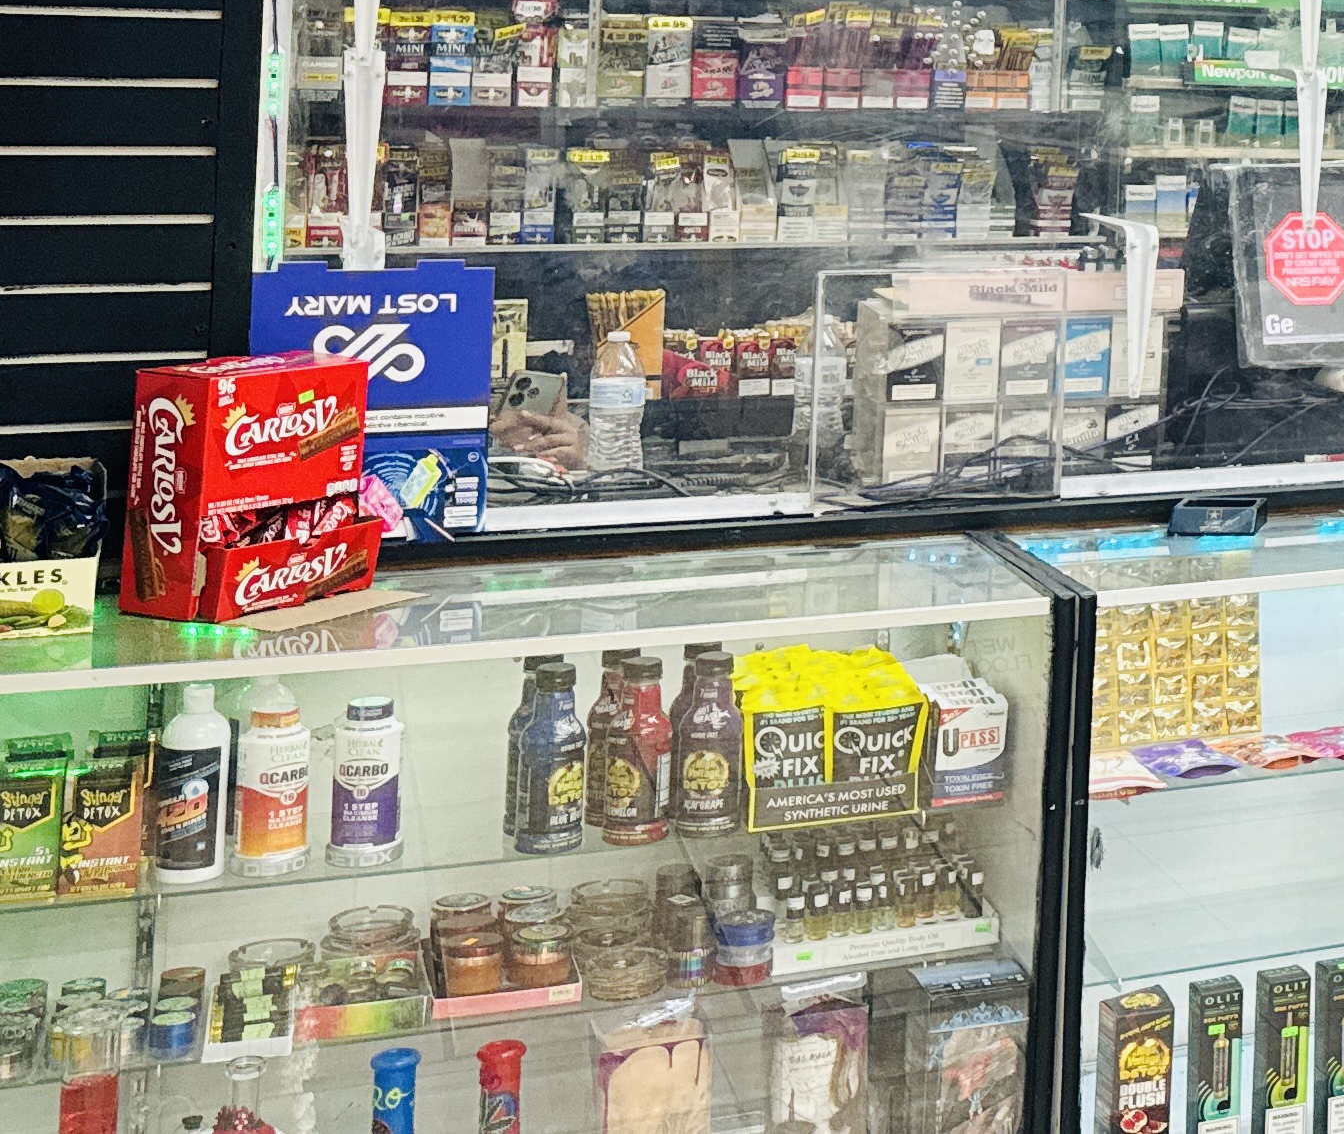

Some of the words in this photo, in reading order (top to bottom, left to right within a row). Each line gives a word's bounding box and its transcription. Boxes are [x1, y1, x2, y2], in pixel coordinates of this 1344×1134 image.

[395, 44, 425, 55] MINI
[436, 43, 466, 54] MINI
[1282, 229, 1335, 249] STOP
[284, 295, 370, 316] MARY
[379, 293, 457, 313] LOST
[1266, 314, 1293, 334] Ge
[218, 378, 236, 395] 96
[834, 725, 914, 756] QUICK
[339, 764, 389, 776] QCARBO
[783, 757, 819, 777] FIX
[860, 754, 895, 774] FIX
[2, 790, 44, 808] Stinger
[81, 790, 124, 807] Stinger
[766, 793, 835, 809] AMERICA'S
[838, 789, 872, 802] MOST
[876, 783, 906, 796] USED
[4, 807, 41, 821] DETOX
[84, 806, 120, 817] DETOX
[784, 805, 849, 821] SYNTHETIC
[851, 802, 888, 814] URINE
[1273, 980, 1309, 993] OLIT
[1205, 992, 1240, 1005] OLIT
[1120, 1080, 1166, 1096] DOUBLE
[1119, 1094, 1166, 1110] FLUSH
